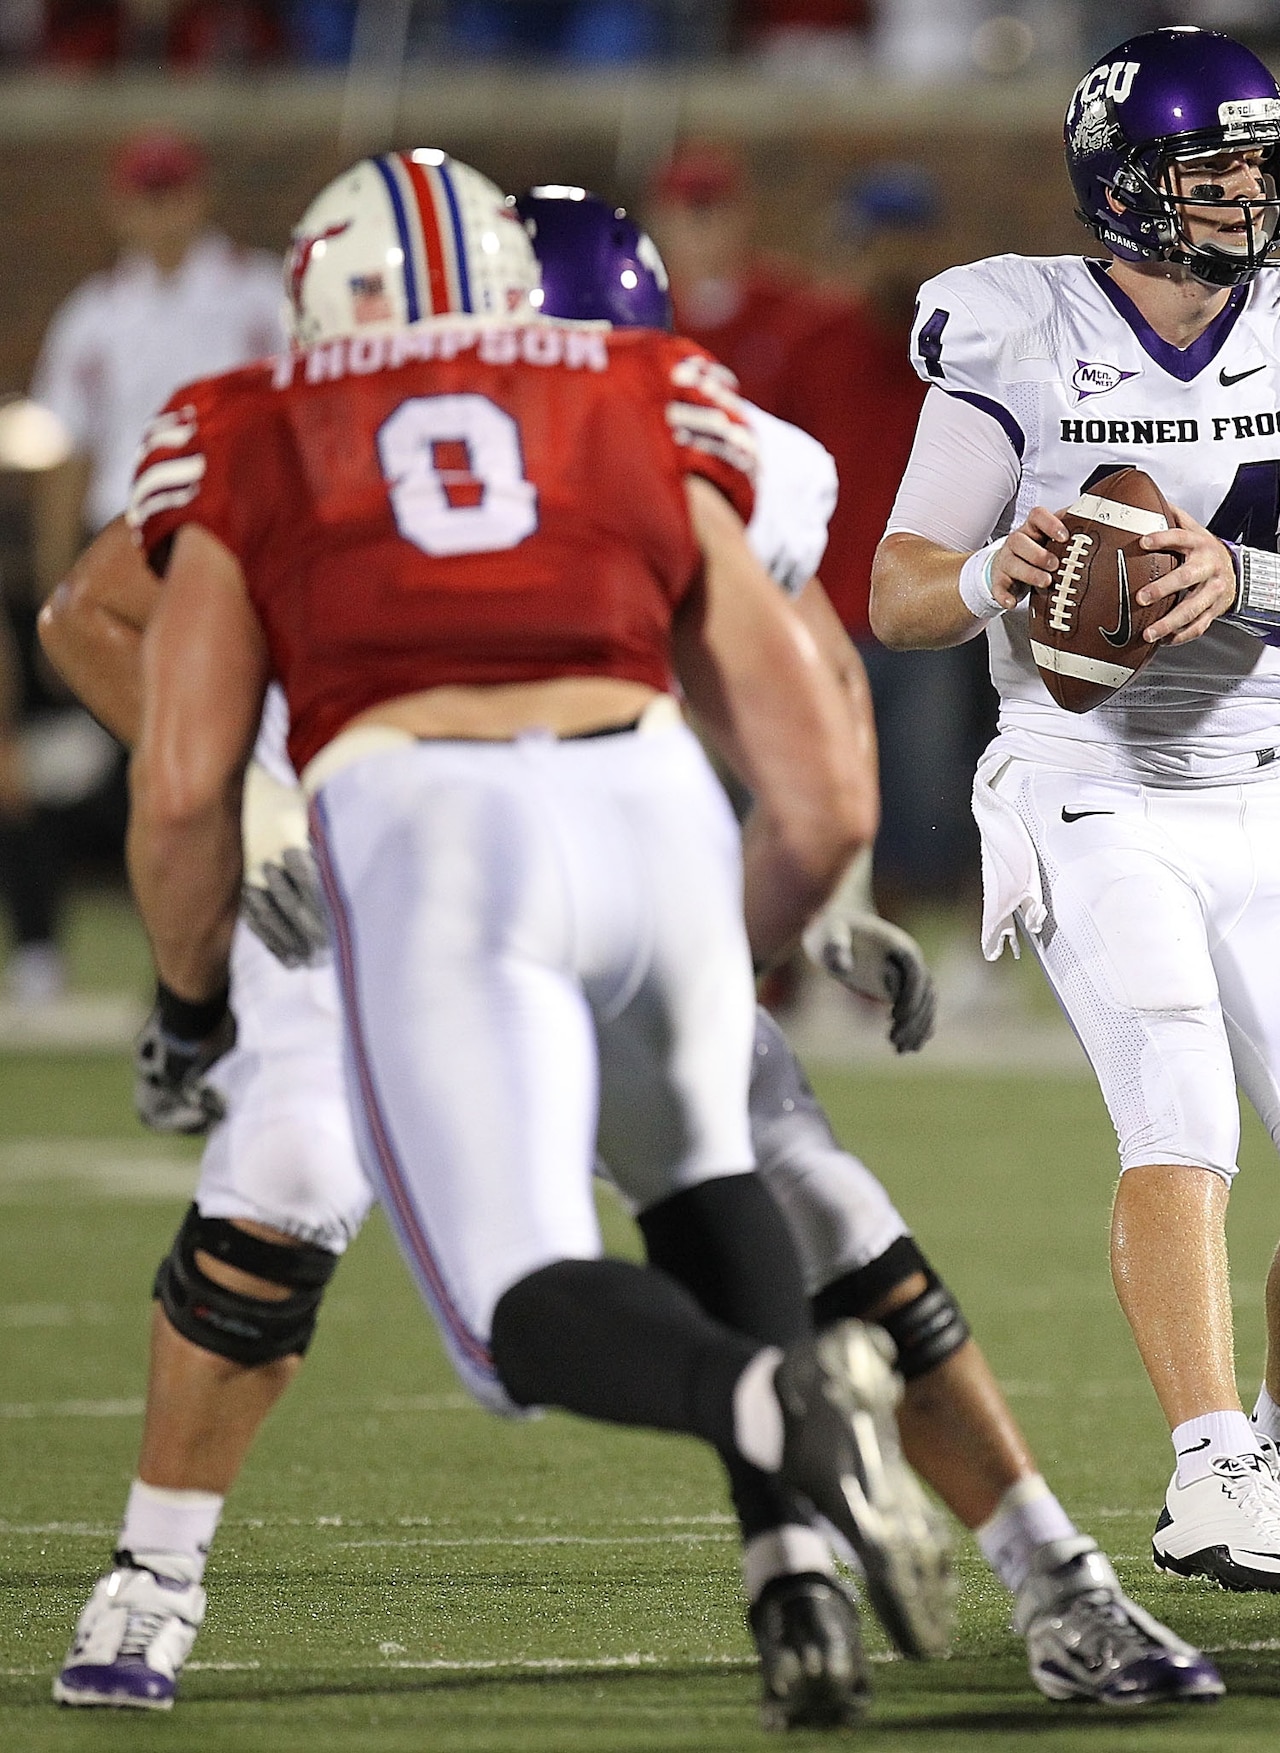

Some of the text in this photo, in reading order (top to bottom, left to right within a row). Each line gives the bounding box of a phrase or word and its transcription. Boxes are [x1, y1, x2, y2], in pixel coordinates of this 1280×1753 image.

[1066, 62, 1141, 125] TCU
[1103, 229, 1139, 252] ADAMS
[1060, 419, 1198, 443] HORNED
